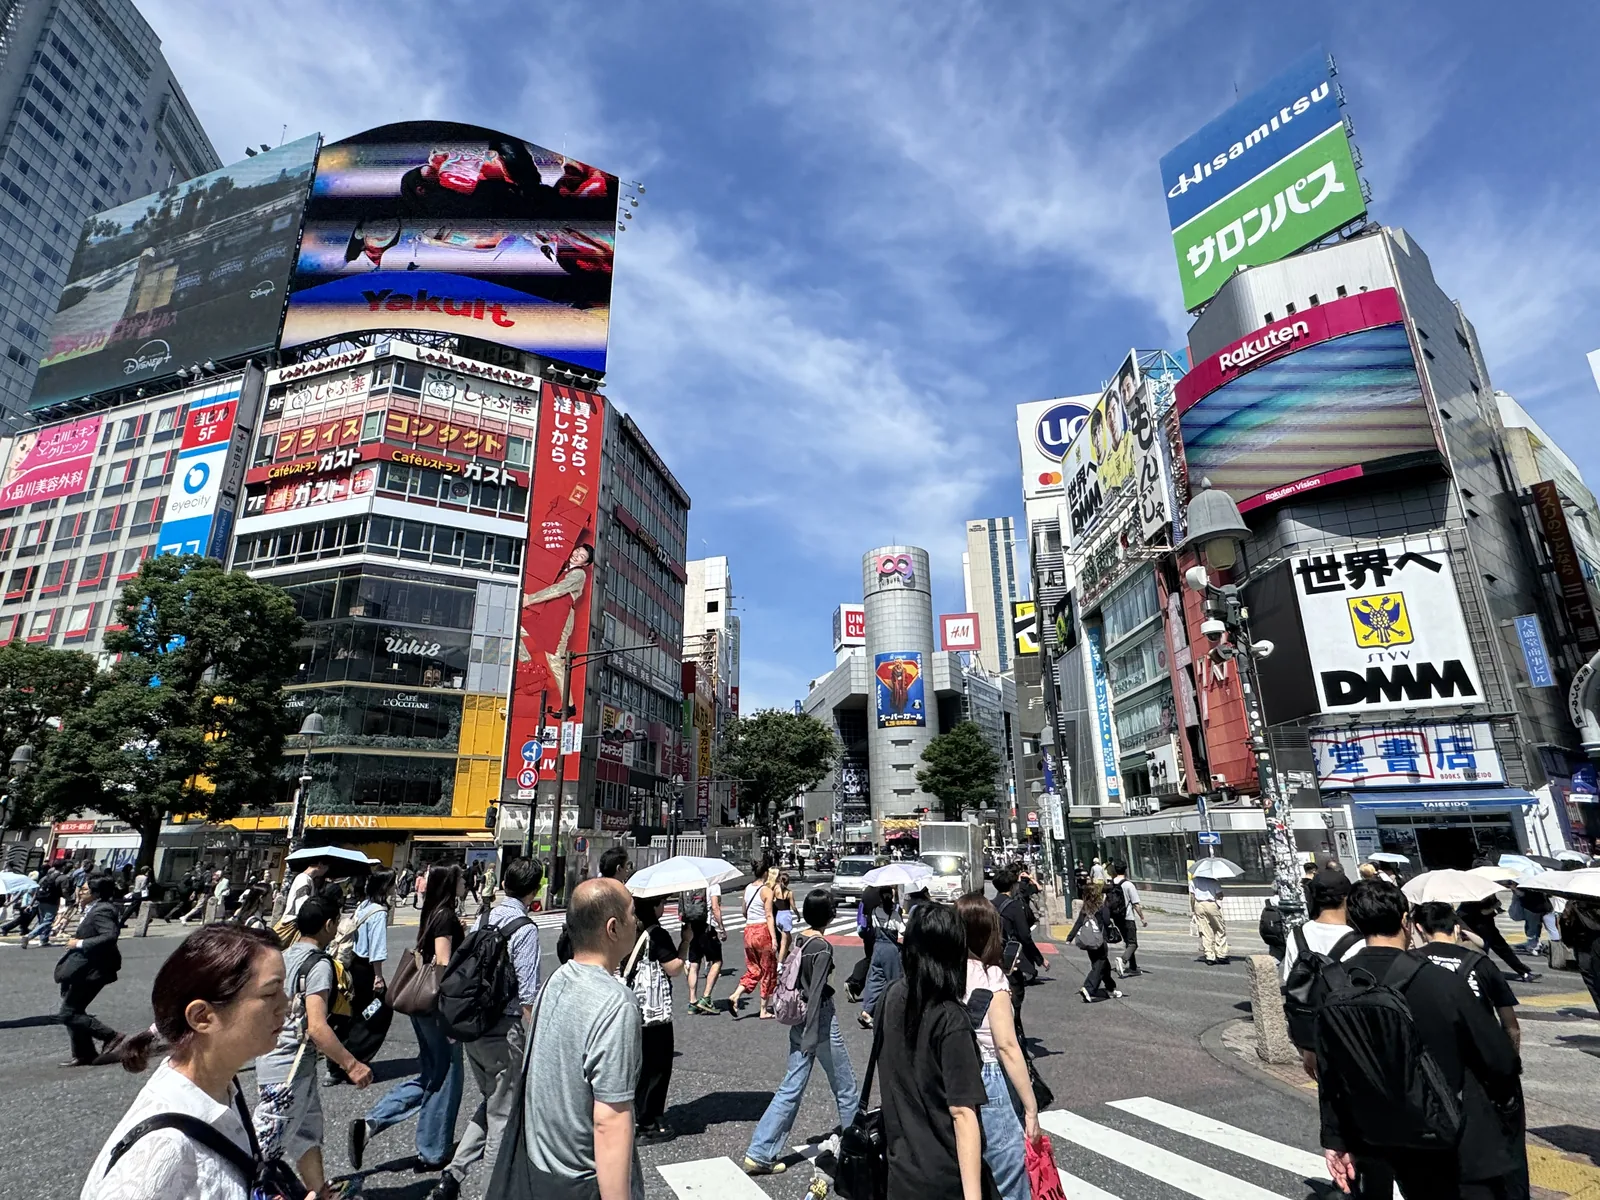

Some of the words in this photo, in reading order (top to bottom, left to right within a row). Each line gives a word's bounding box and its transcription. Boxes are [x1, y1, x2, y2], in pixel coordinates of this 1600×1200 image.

[1168, 82, 1330, 198] Hisamitsu
[1187, 161, 1345, 278] サロンパス
[361, 289, 515, 327] Yakult
[1219, 321, 1309, 372] Rakuten
[416, 347, 535, 386] しゃぶしゃぶバイキング
[315, 376, 365, 400] しゃぶ葉
[464, 383, 532, 414] しゃぶ葉
[269, 397, 285, 410] 9F
[51, 426, 95, 446] 品川スキン
[198, 425, 217, 442] 5F
[387, 414, 503, 453] コンタクト
[551, 397, 571, 472] 推しから。
[572, 400, 591, 476] 買うなら、
[47, 440, 88, 459] クリニック
[318, 448, 361, 472] ガスト
[392, 451, 461, 473] Caféレストラン
[464, 462, 516, 486] ガスト
[11, 470, 84, 500] 品川美容外科
[1068, 461, 1097, 511] 世界へ
[1265, 486, 1295, 500] Rakuten
[1295, 479, 1320, 490] Vision
[171, 495, 212, 515] eyecity
[248, 495, 266, 511] 7F
[1072, 480, 1103, 537] DMM
[1296, 549, 1443, 595] 世界へ
[951, 625, 969, 638] H&M
[384, 637, 441, 657] Ushi8
[1366, 650, 1410, 663] STVV
[1320, 659, 1477, 707] DMM
[383, 699, 429, 709] L'OCCITANE
[1312, 735, 1478, 776] 堂書店
[280, 815, 378, 827] L'CITANE
